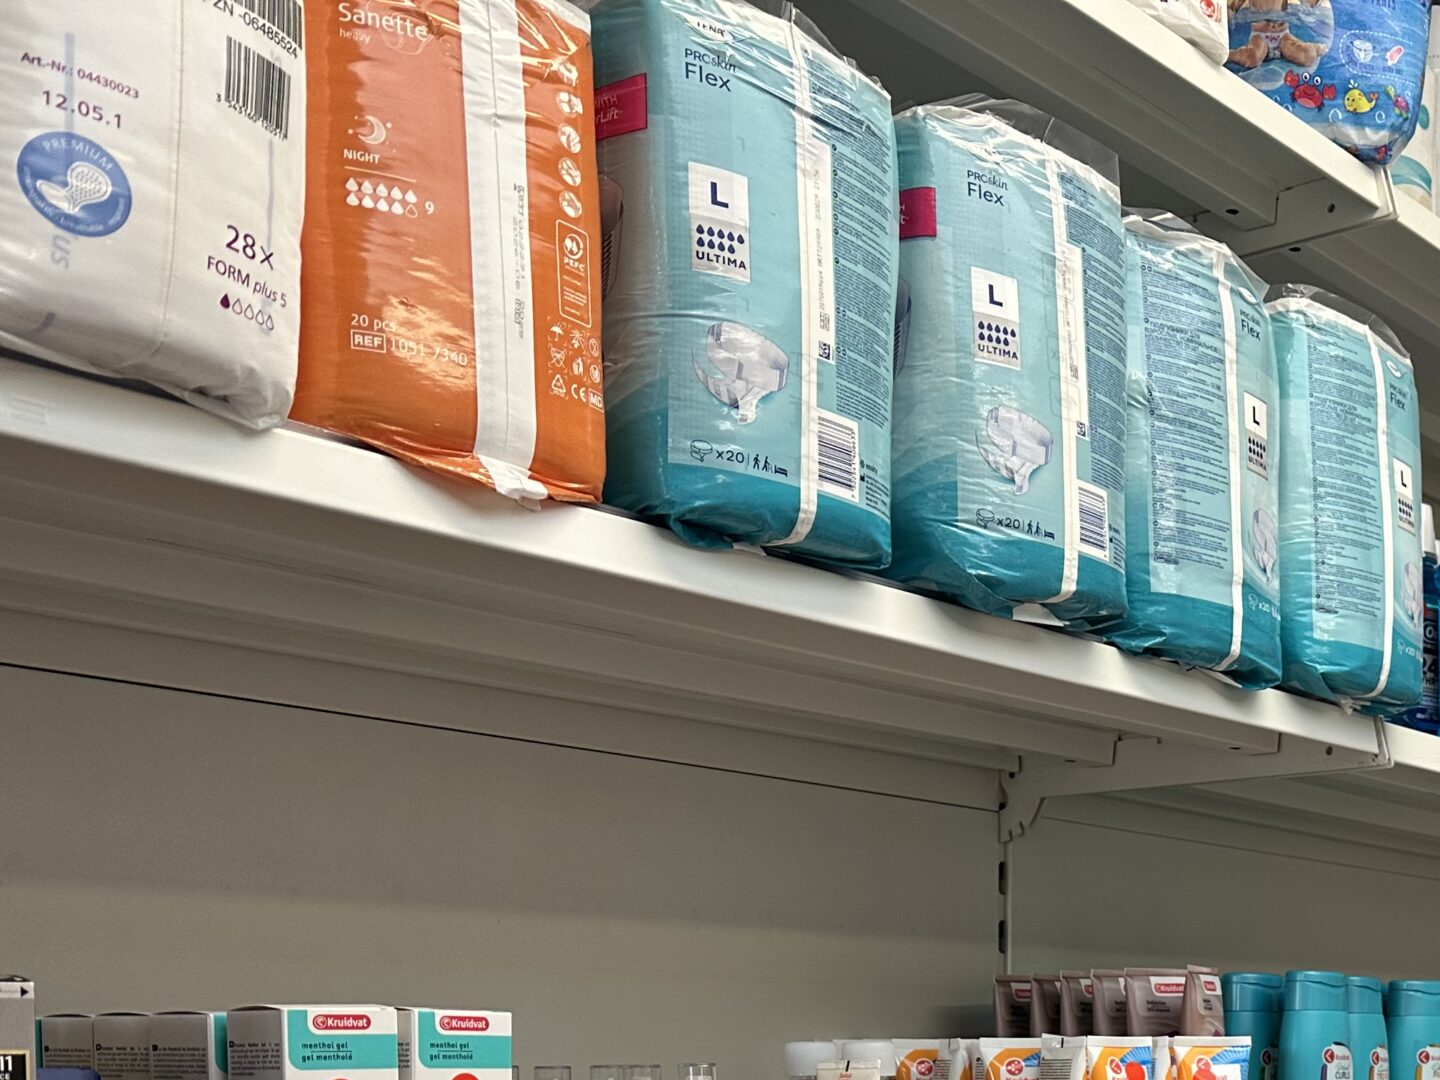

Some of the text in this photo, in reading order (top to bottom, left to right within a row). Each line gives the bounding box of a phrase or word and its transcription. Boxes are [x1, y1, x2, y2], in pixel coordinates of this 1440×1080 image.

[338, 2, 428, 41] Sanette
[339, 28, 371, 44] heavy
[685, 62, 732, 92] Flex
[42, 90, 123, 129] 12.05.1
[41, 138, 113, 172] PREMIUM
[343, 148, 381, 165] NIGHT
[709, 181, 730, 209] L
[967, 181, 1005, 207] Flex
[425, 202, 435, 215] 9
[696, 250, 747, 271] ULTIMA
[206, 255, 288, 309] FORM plus 5
[988, 283, 1004, 308] L
[351, 314, 369, 328] 20
[1241, 320, 1261, 341] Flex
[353, 335, 383, 349] REF
[432, 345, 468, 367] 7340
[977, 343, 1019, 361] ULTIMA
[1252, 405, 1261, 426] L
[716, 451, 745, 465] x20
[1400, 469, 1407, 488] L
[996, 517, 1021, 530] x20
[327, 1016, 368, 1029] Kruidvat
[451, 1017, 487, 1029] Kruidvat
[301, 1041, 348, 1051] menthol gel
[429, 1041, 470, 1051] menthol gel
[301, 1052, 353, 1063] gel mentholé
[429, 1052, 473, 1062] gel mentholé
